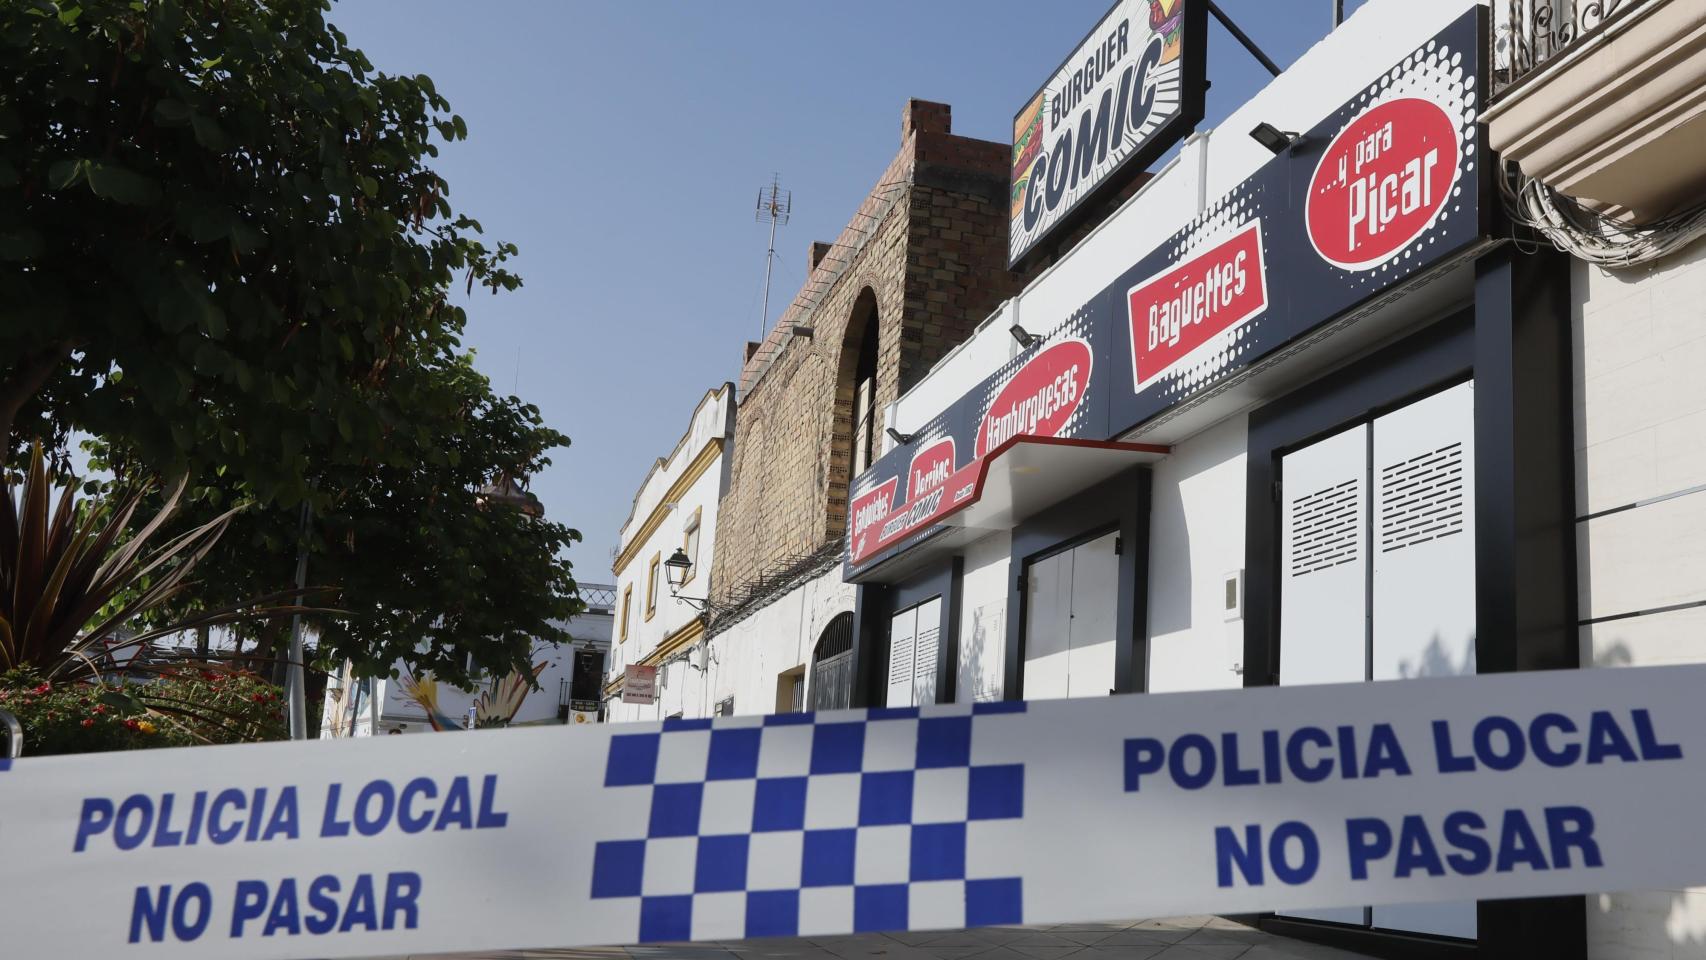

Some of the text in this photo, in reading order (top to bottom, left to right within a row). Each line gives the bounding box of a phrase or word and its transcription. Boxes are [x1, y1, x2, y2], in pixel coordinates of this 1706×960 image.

[1050, 18, 1130, 132] BURGUER
[1024, 35, 1163, 234] COMIC
[1355, 121, 1393, 174] para
[1349, 147, 1438, 252] Picar
[986, 364, 1078, 454] Hamburguesas
[1122, 708, 1684, 792] POLICIA LOCAL
[72, 774, 509, 853] POLICIA LOCAL
[1214, 805, 1604, 888] NO PASAR
[128, 871, 423, 944] NO PASAR
